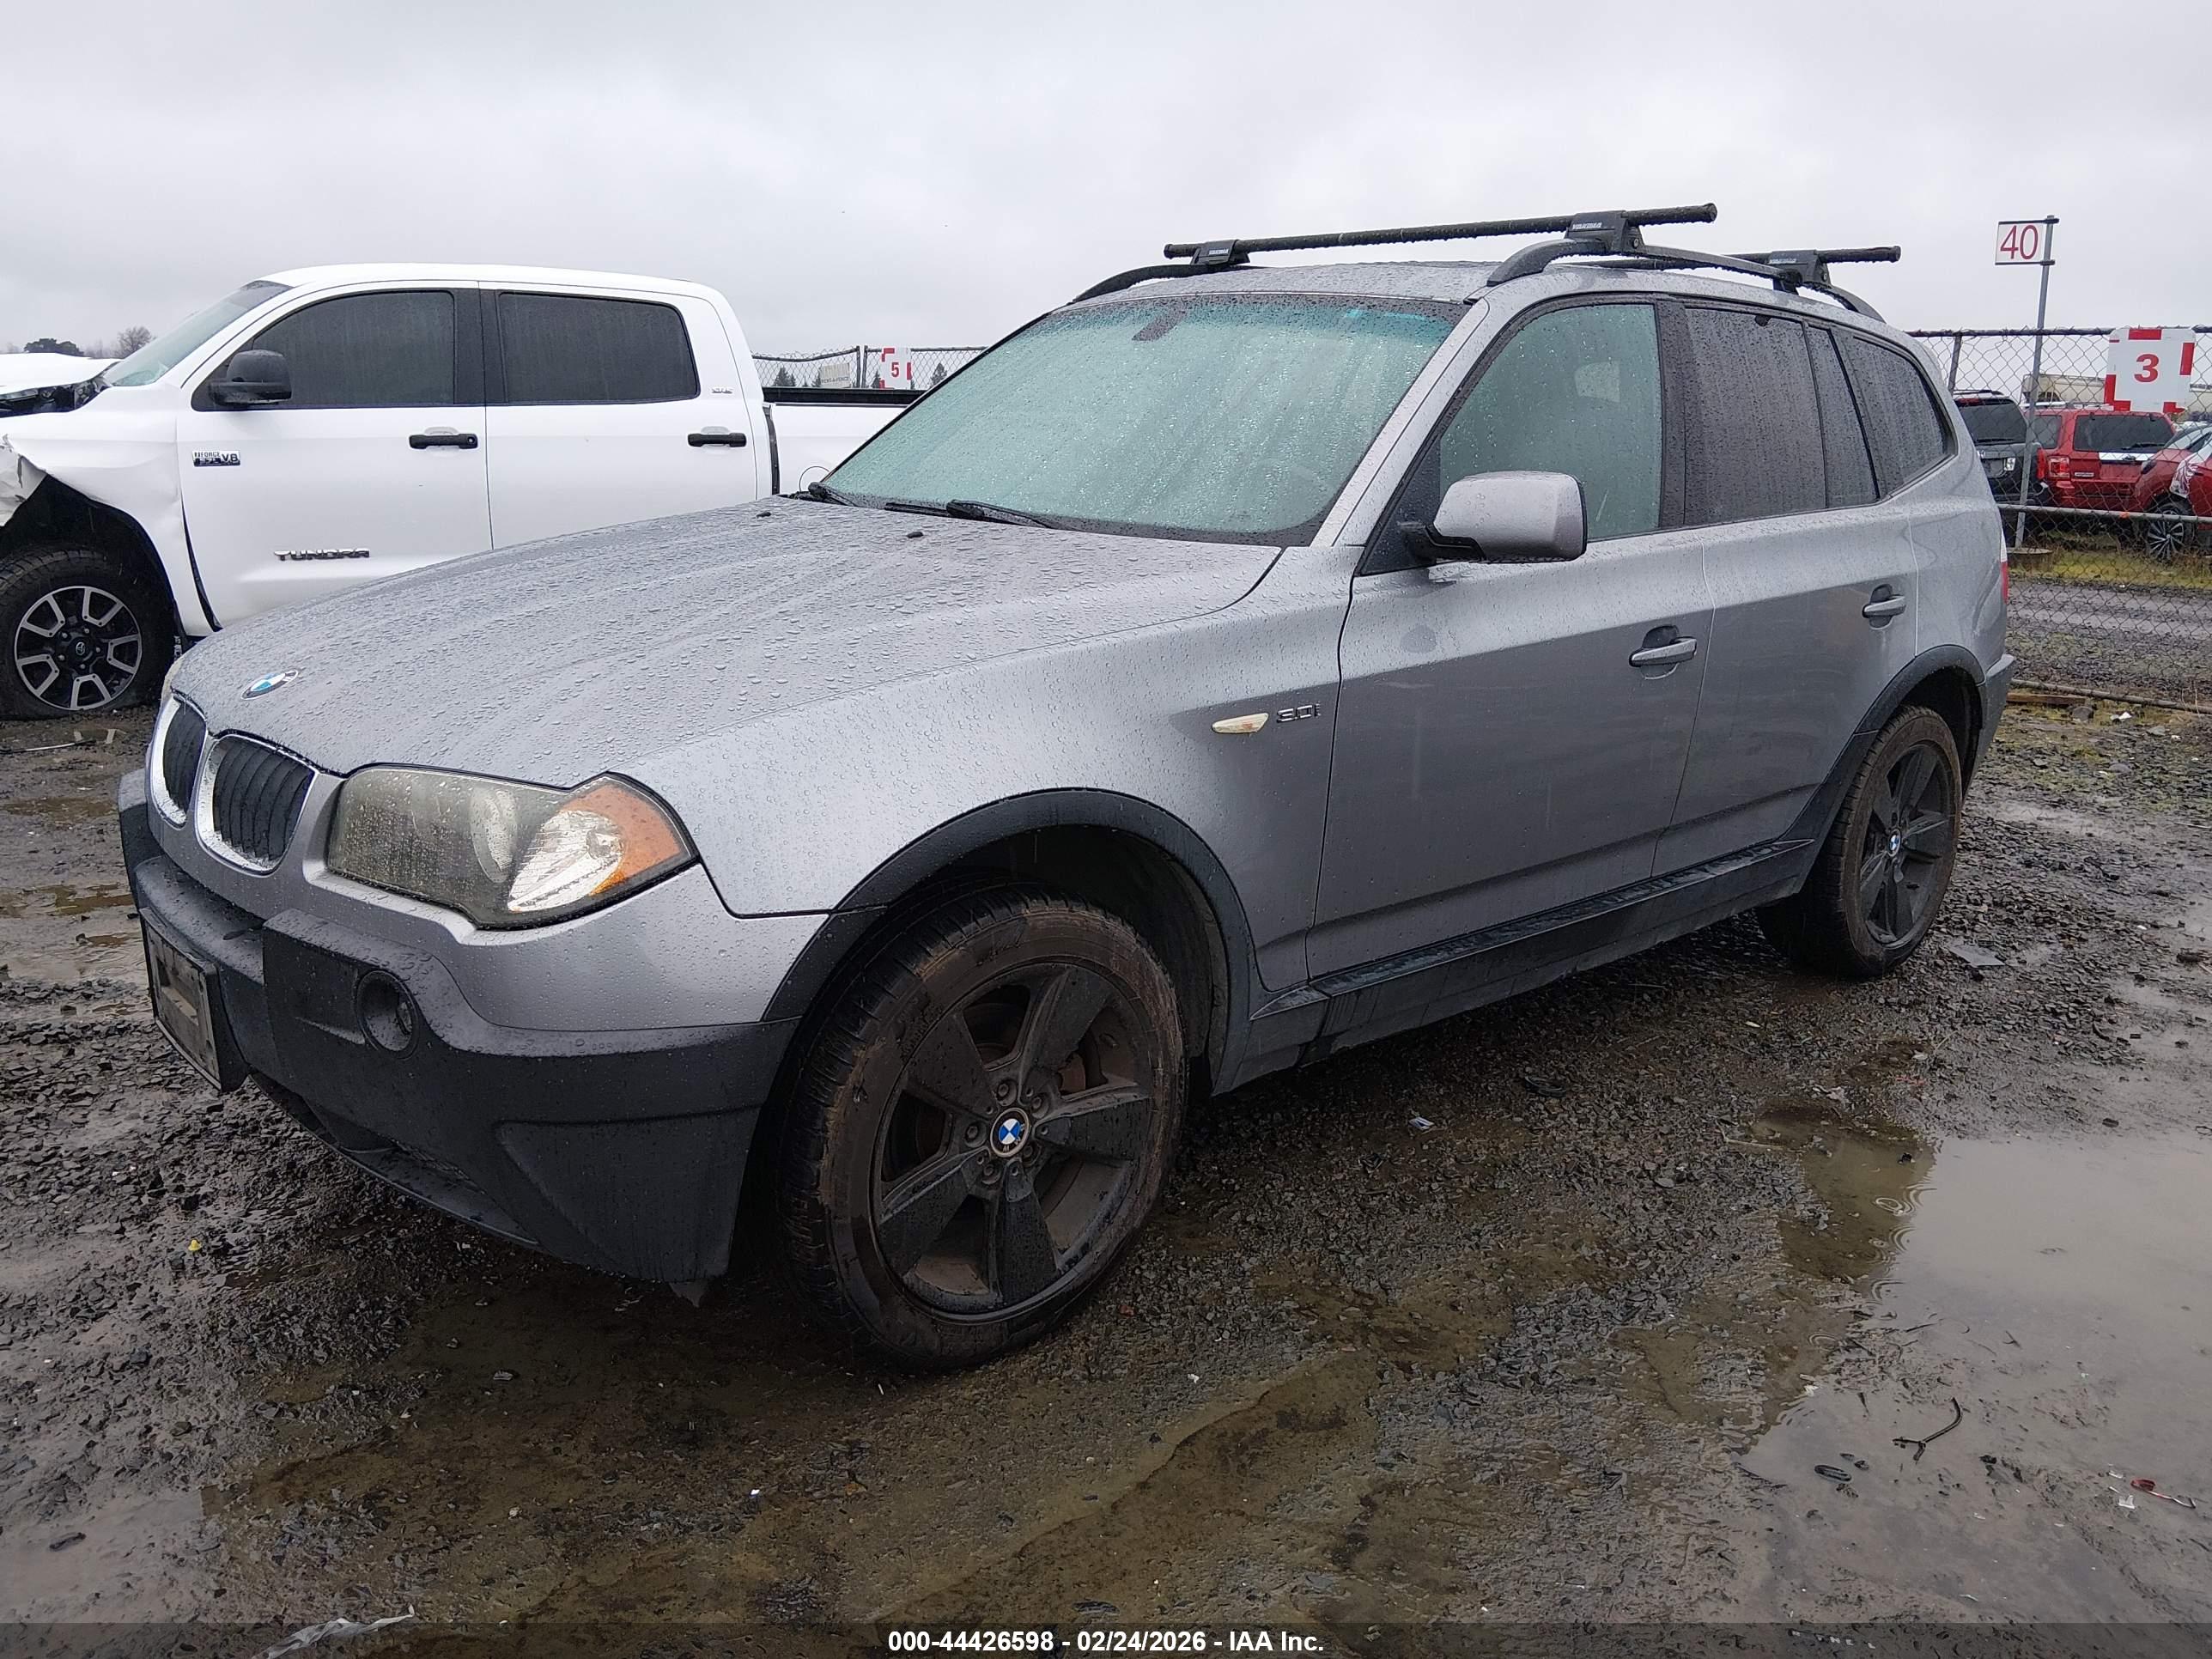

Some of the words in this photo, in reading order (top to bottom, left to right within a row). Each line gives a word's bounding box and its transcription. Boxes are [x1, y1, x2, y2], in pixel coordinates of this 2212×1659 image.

[2000, 224, 2039, 259] 40
[890, 362, 900, 378] 5
[2134, 353, 2160, 383] 3
[274, 548, 370, 561] TUNDRA
